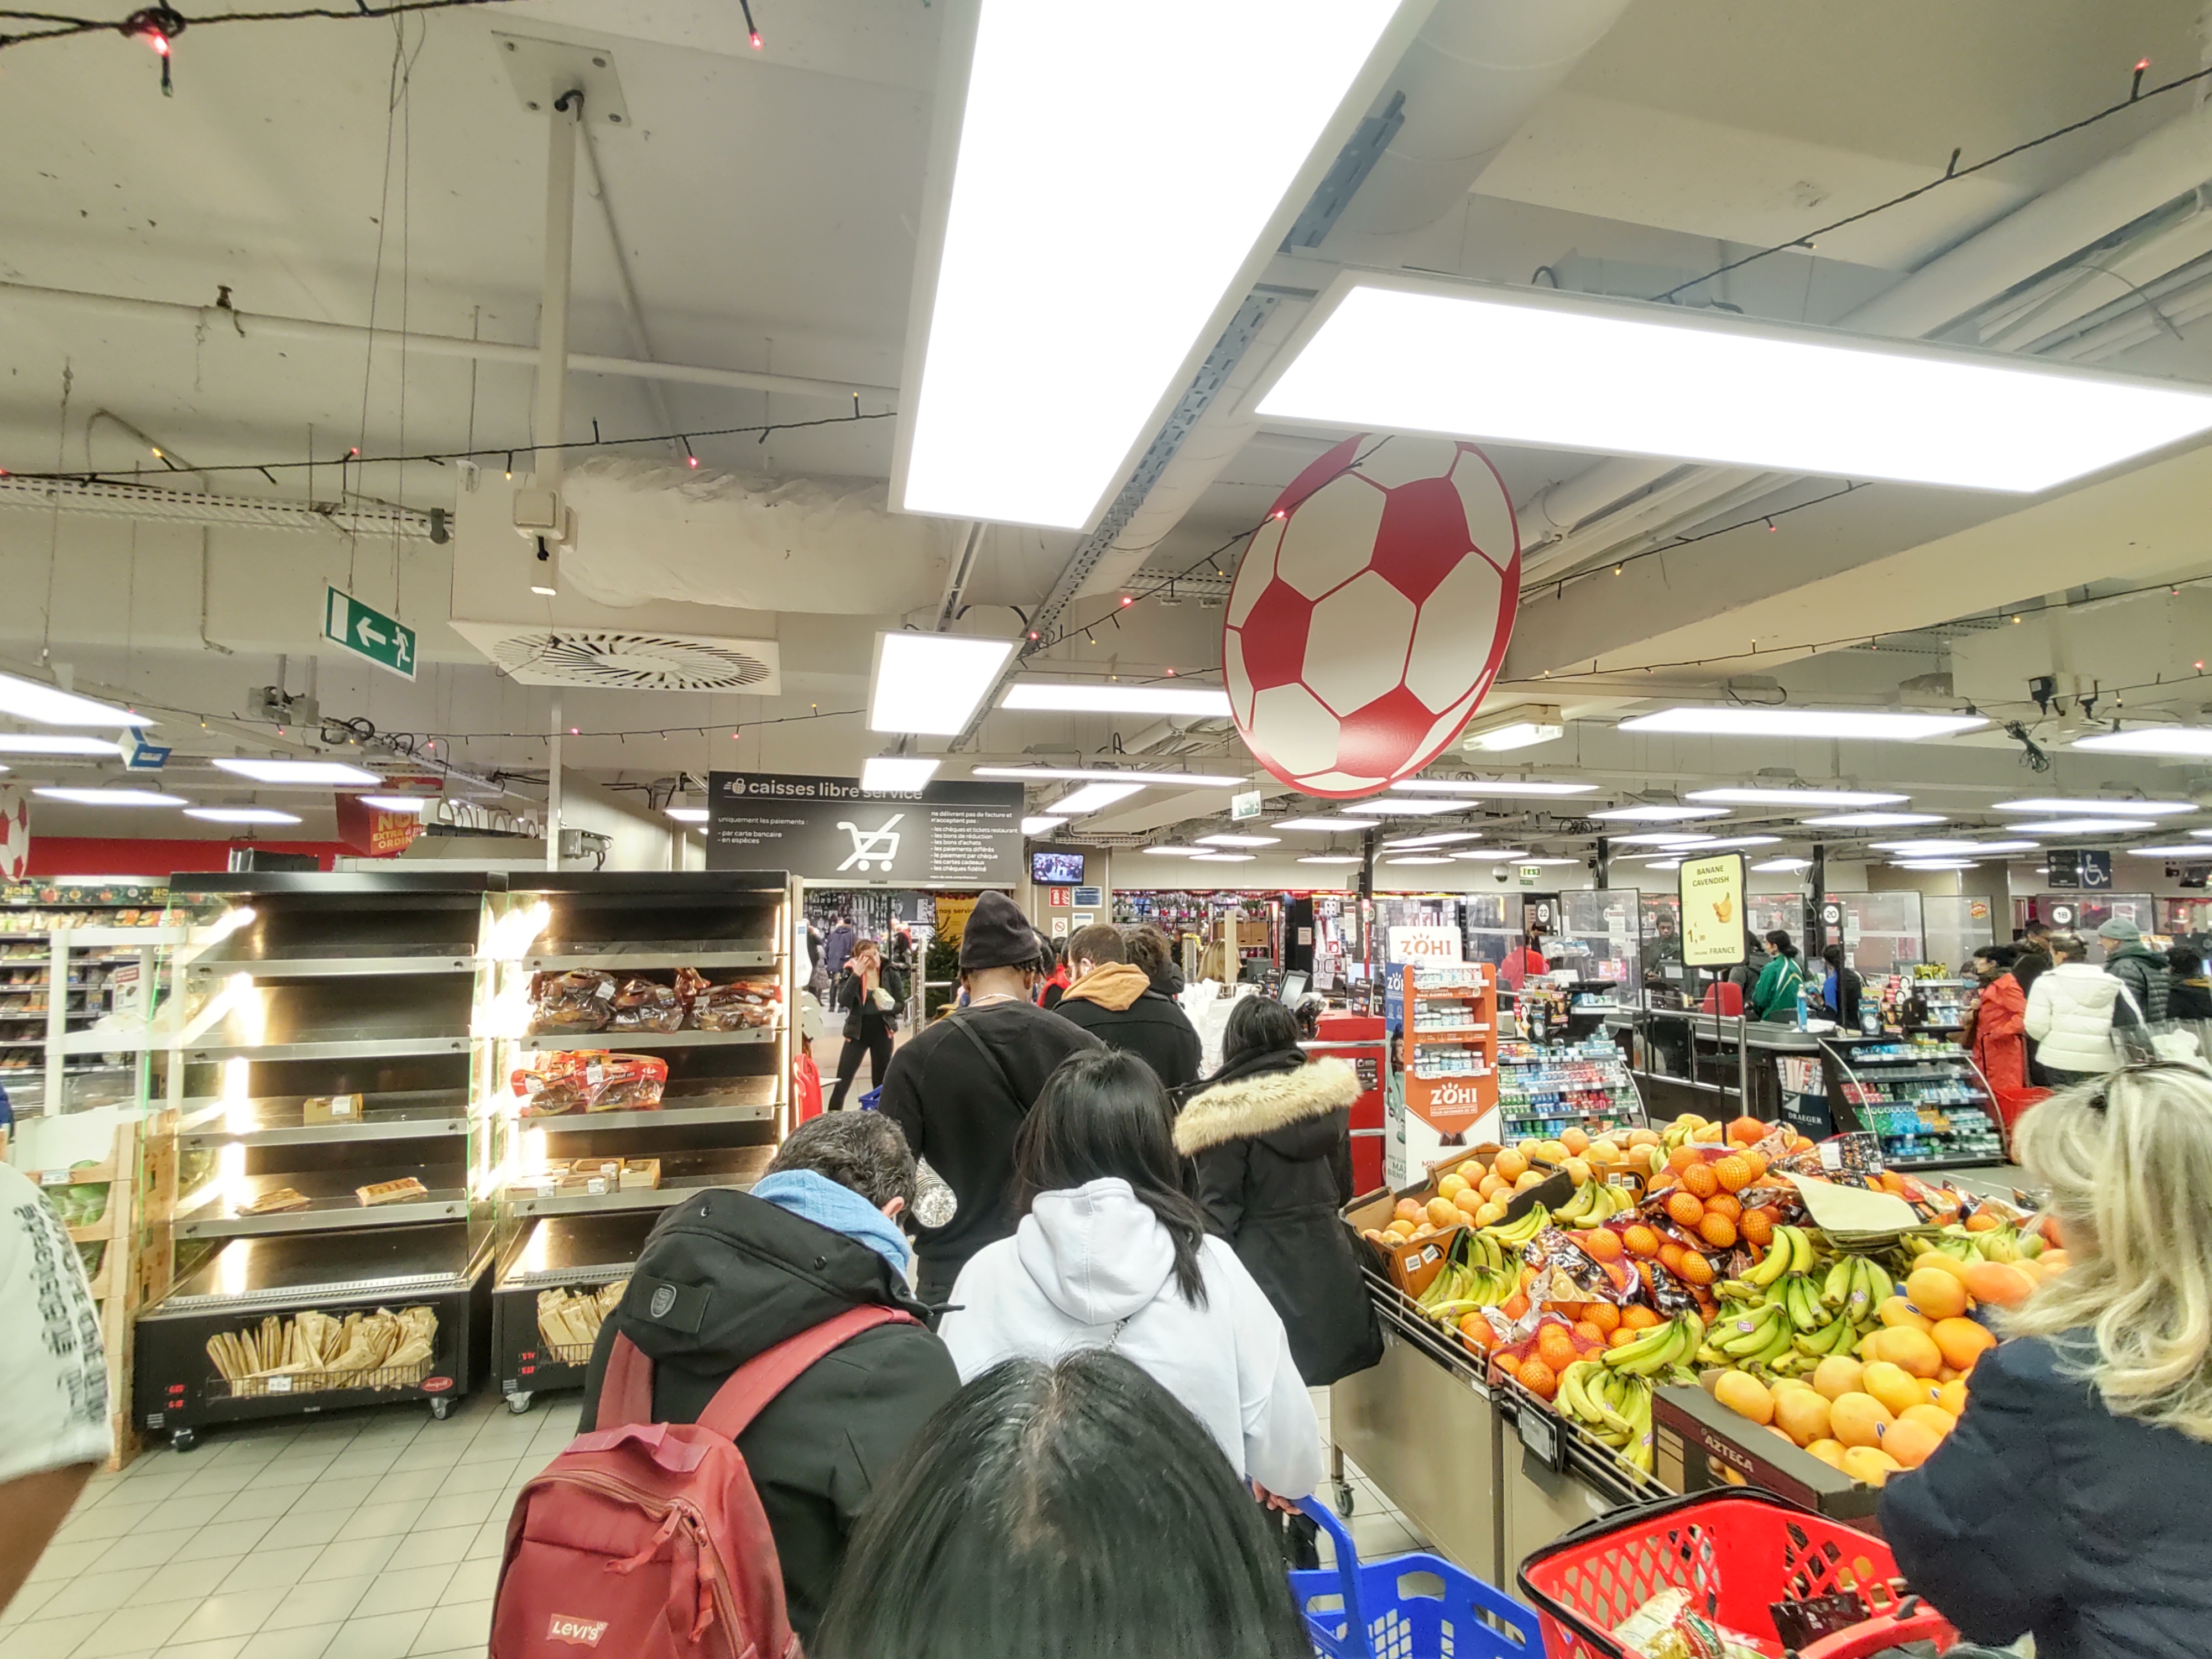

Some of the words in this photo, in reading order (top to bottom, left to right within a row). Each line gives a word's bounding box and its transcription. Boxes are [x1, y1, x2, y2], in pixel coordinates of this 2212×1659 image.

[749, 779, 815, 796] caisses
[819, 782, 859, 797] libre
[373, 830, 404, 841] EXTRA
[942, 826, 966, 834] chèques
[378, 836, 413, 849] ORDIN
[1697, 865, 1724, 875] BANANE
[1692, 875, 1730, 887] CAVENDISH
[1539, 909, 1547, 917] 22
[1826, 910, 1837, 919] 20
[1709, 946, 1736, 955] FRANCE
[1788, 1112, 1823, 1125] DRAEGER
[1704, 1434, 1754, 1473] AZTECA
